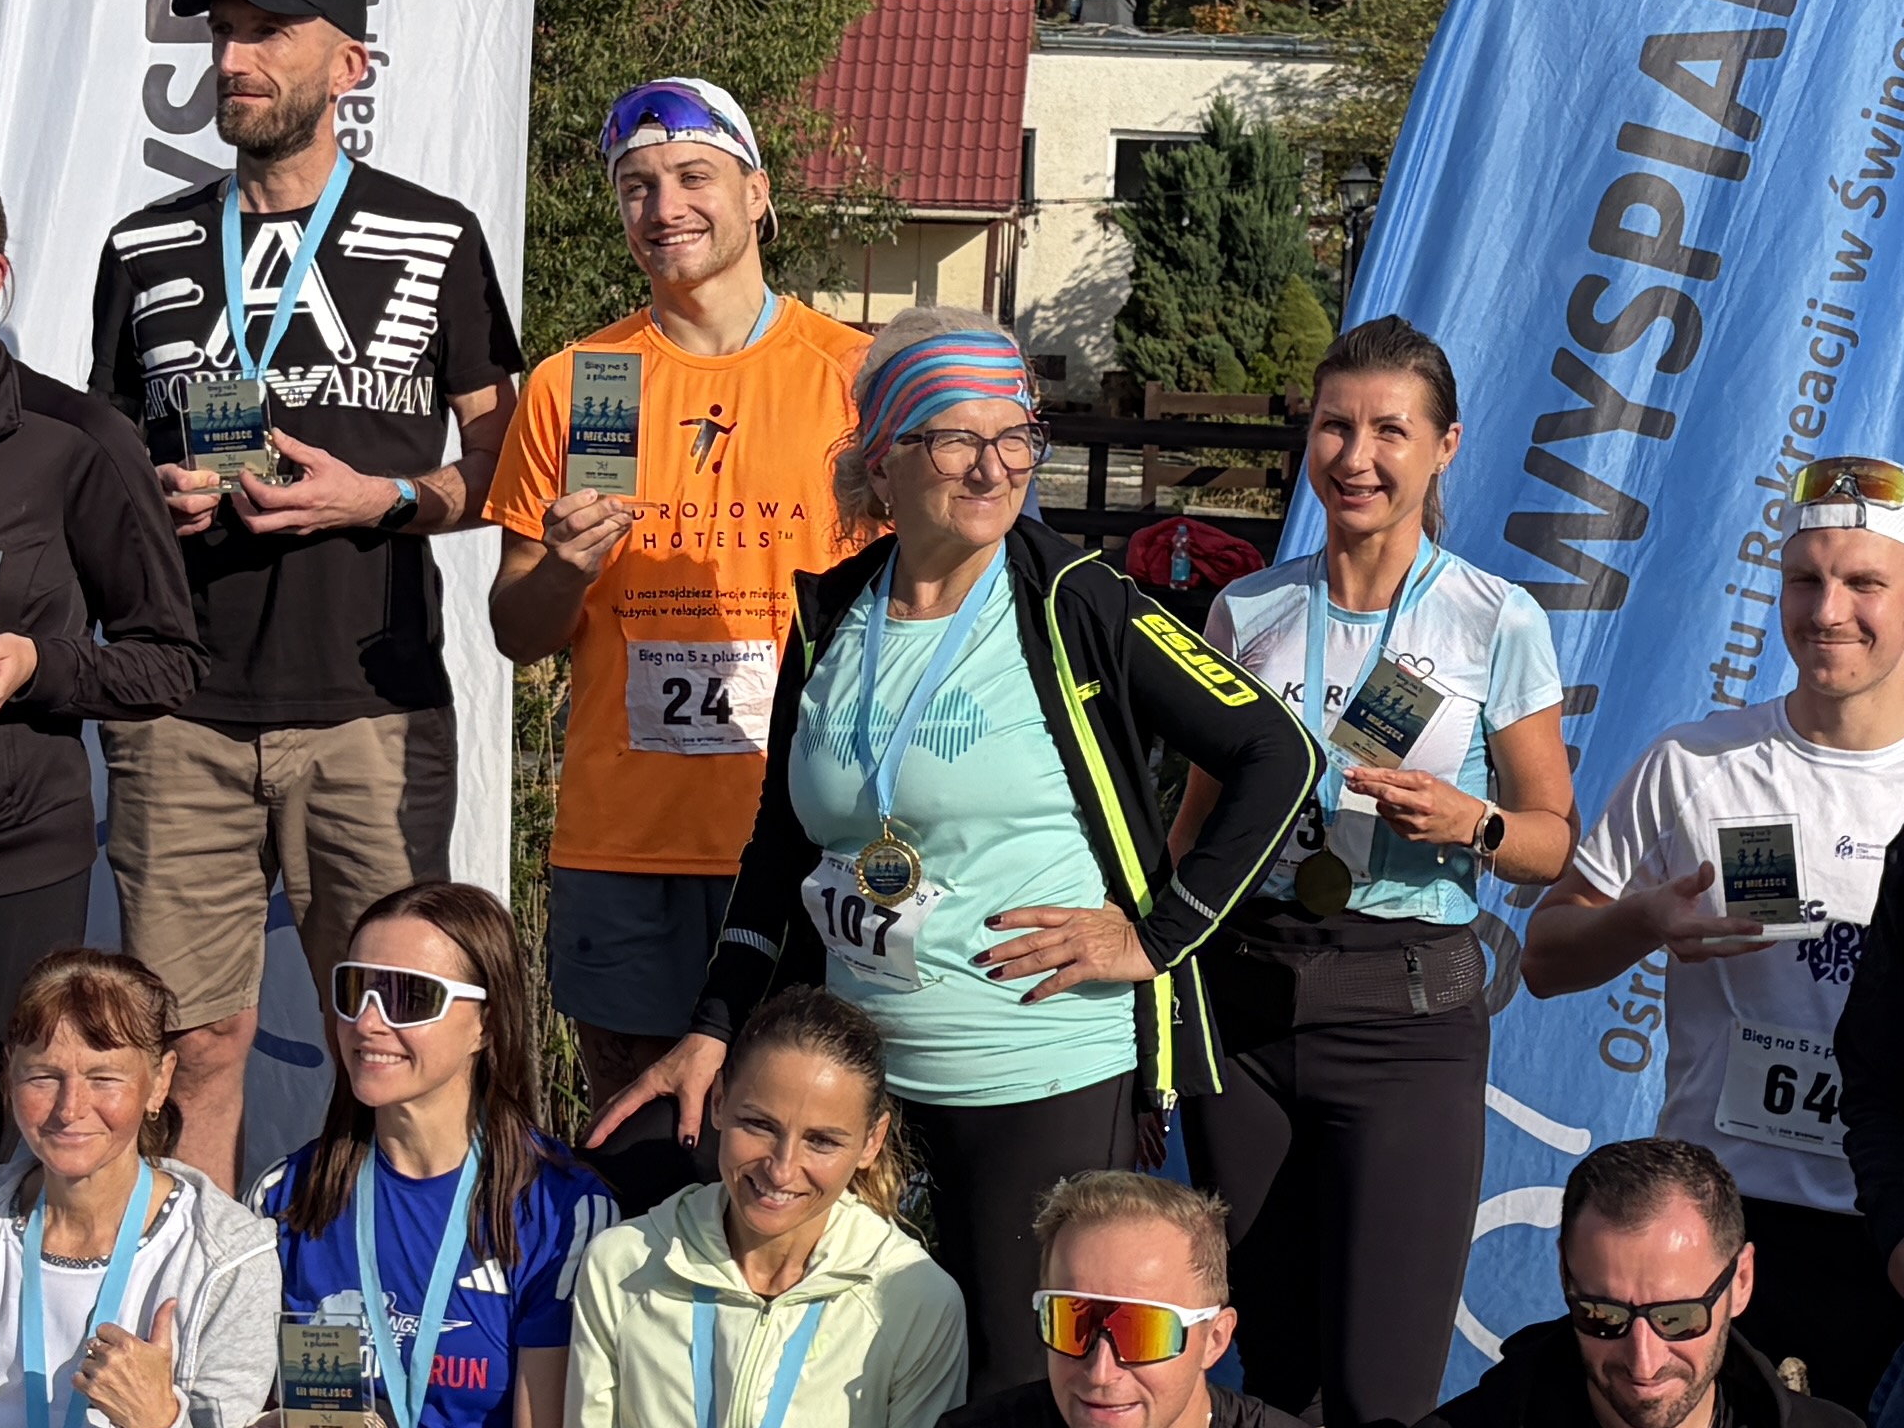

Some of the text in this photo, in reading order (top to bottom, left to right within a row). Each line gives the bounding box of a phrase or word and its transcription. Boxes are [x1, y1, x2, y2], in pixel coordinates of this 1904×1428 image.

[1828, 231, 1876, 287] w
[318, 365, 434, 416] ARMANI
[212, 430, 253, 442] MIEJSCE
[583, 431, 632, 444] MIEJSCE
[639, 648, 764, 666] Bieg na 5 z plusem
[662, 676, 733, 725] 24
[1745, 877, 1788, 888] MIEJSCE
[820, 886, 902, 958] 107
[1742, 1027, 1821, 1054] Bieg na 5 z
[1763, 1063, 1840, 1125] 64
[429, 1353, 488, 1389] RUN
[308, 1387, 353, 1398] MIEJSCE
